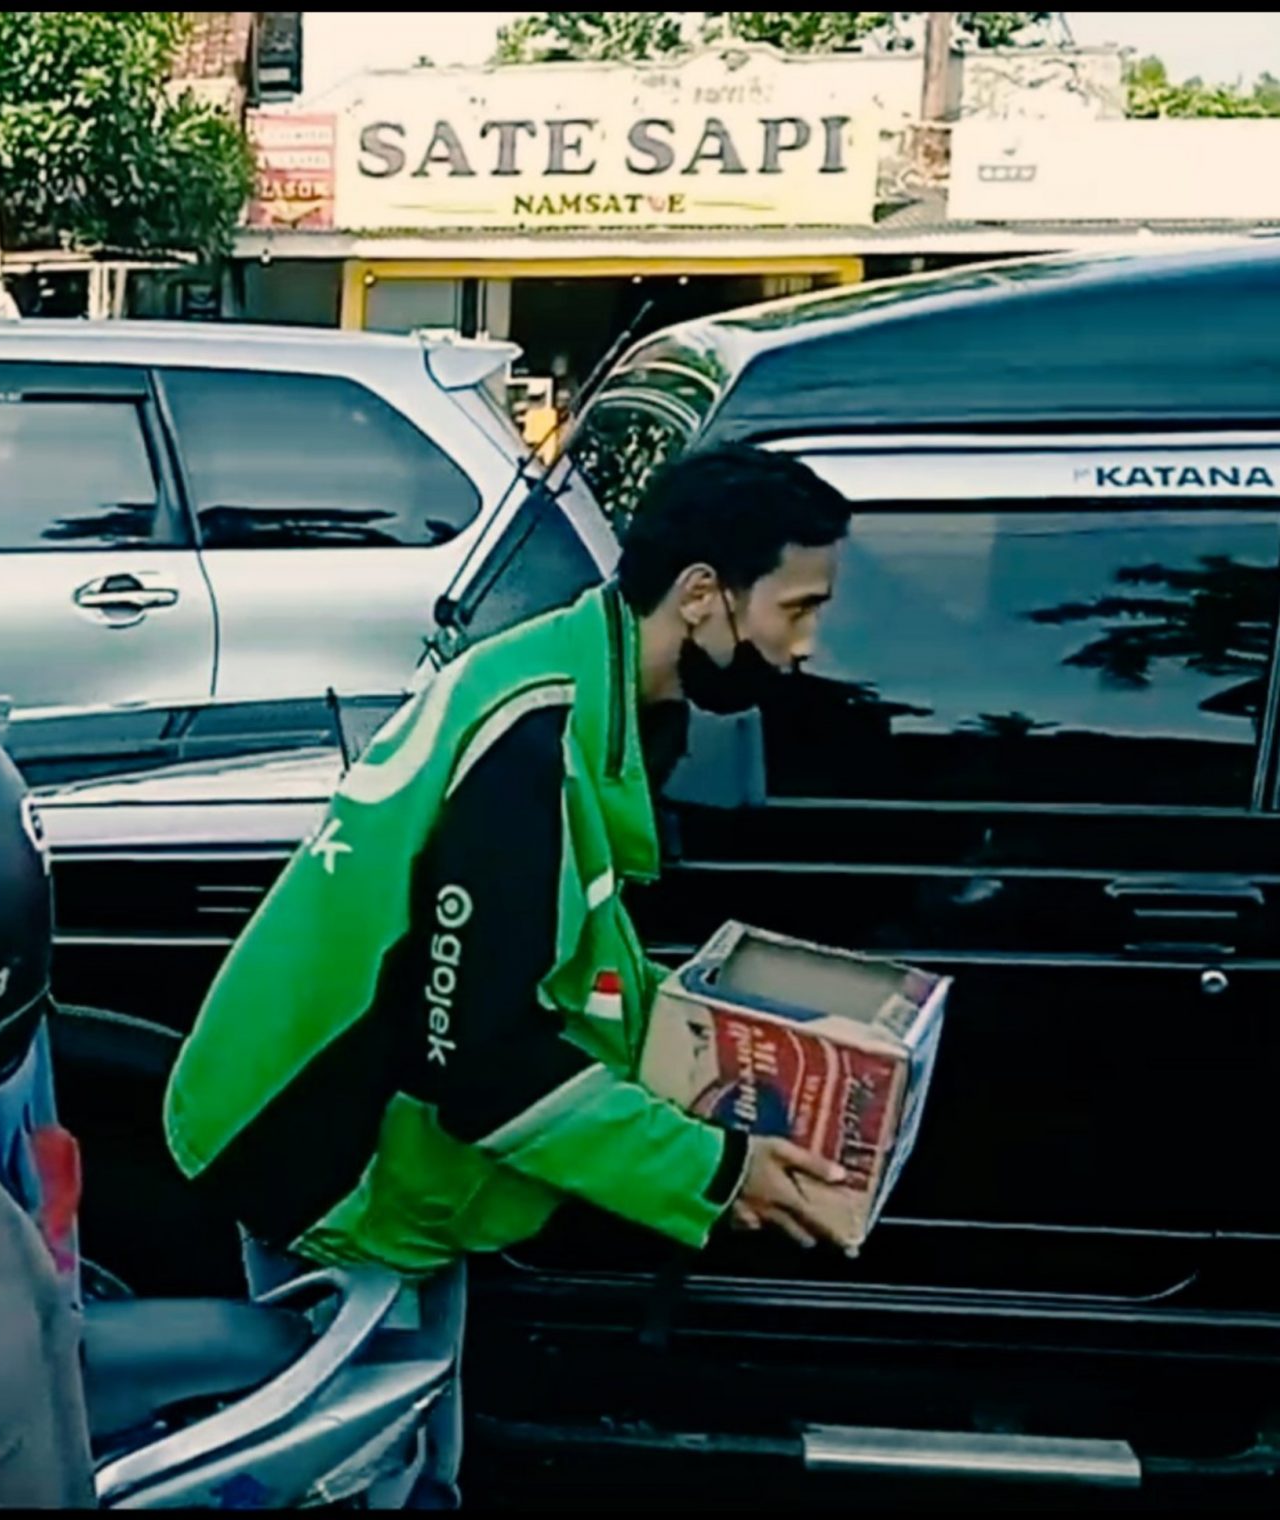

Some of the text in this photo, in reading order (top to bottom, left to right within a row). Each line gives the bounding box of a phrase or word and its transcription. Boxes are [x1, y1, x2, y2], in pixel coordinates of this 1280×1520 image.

[356, 116, 851, 179] SATE SAPI
[1095, 465, 1276, 489] KATANA
[425, 933, 462, 1067] gojek
